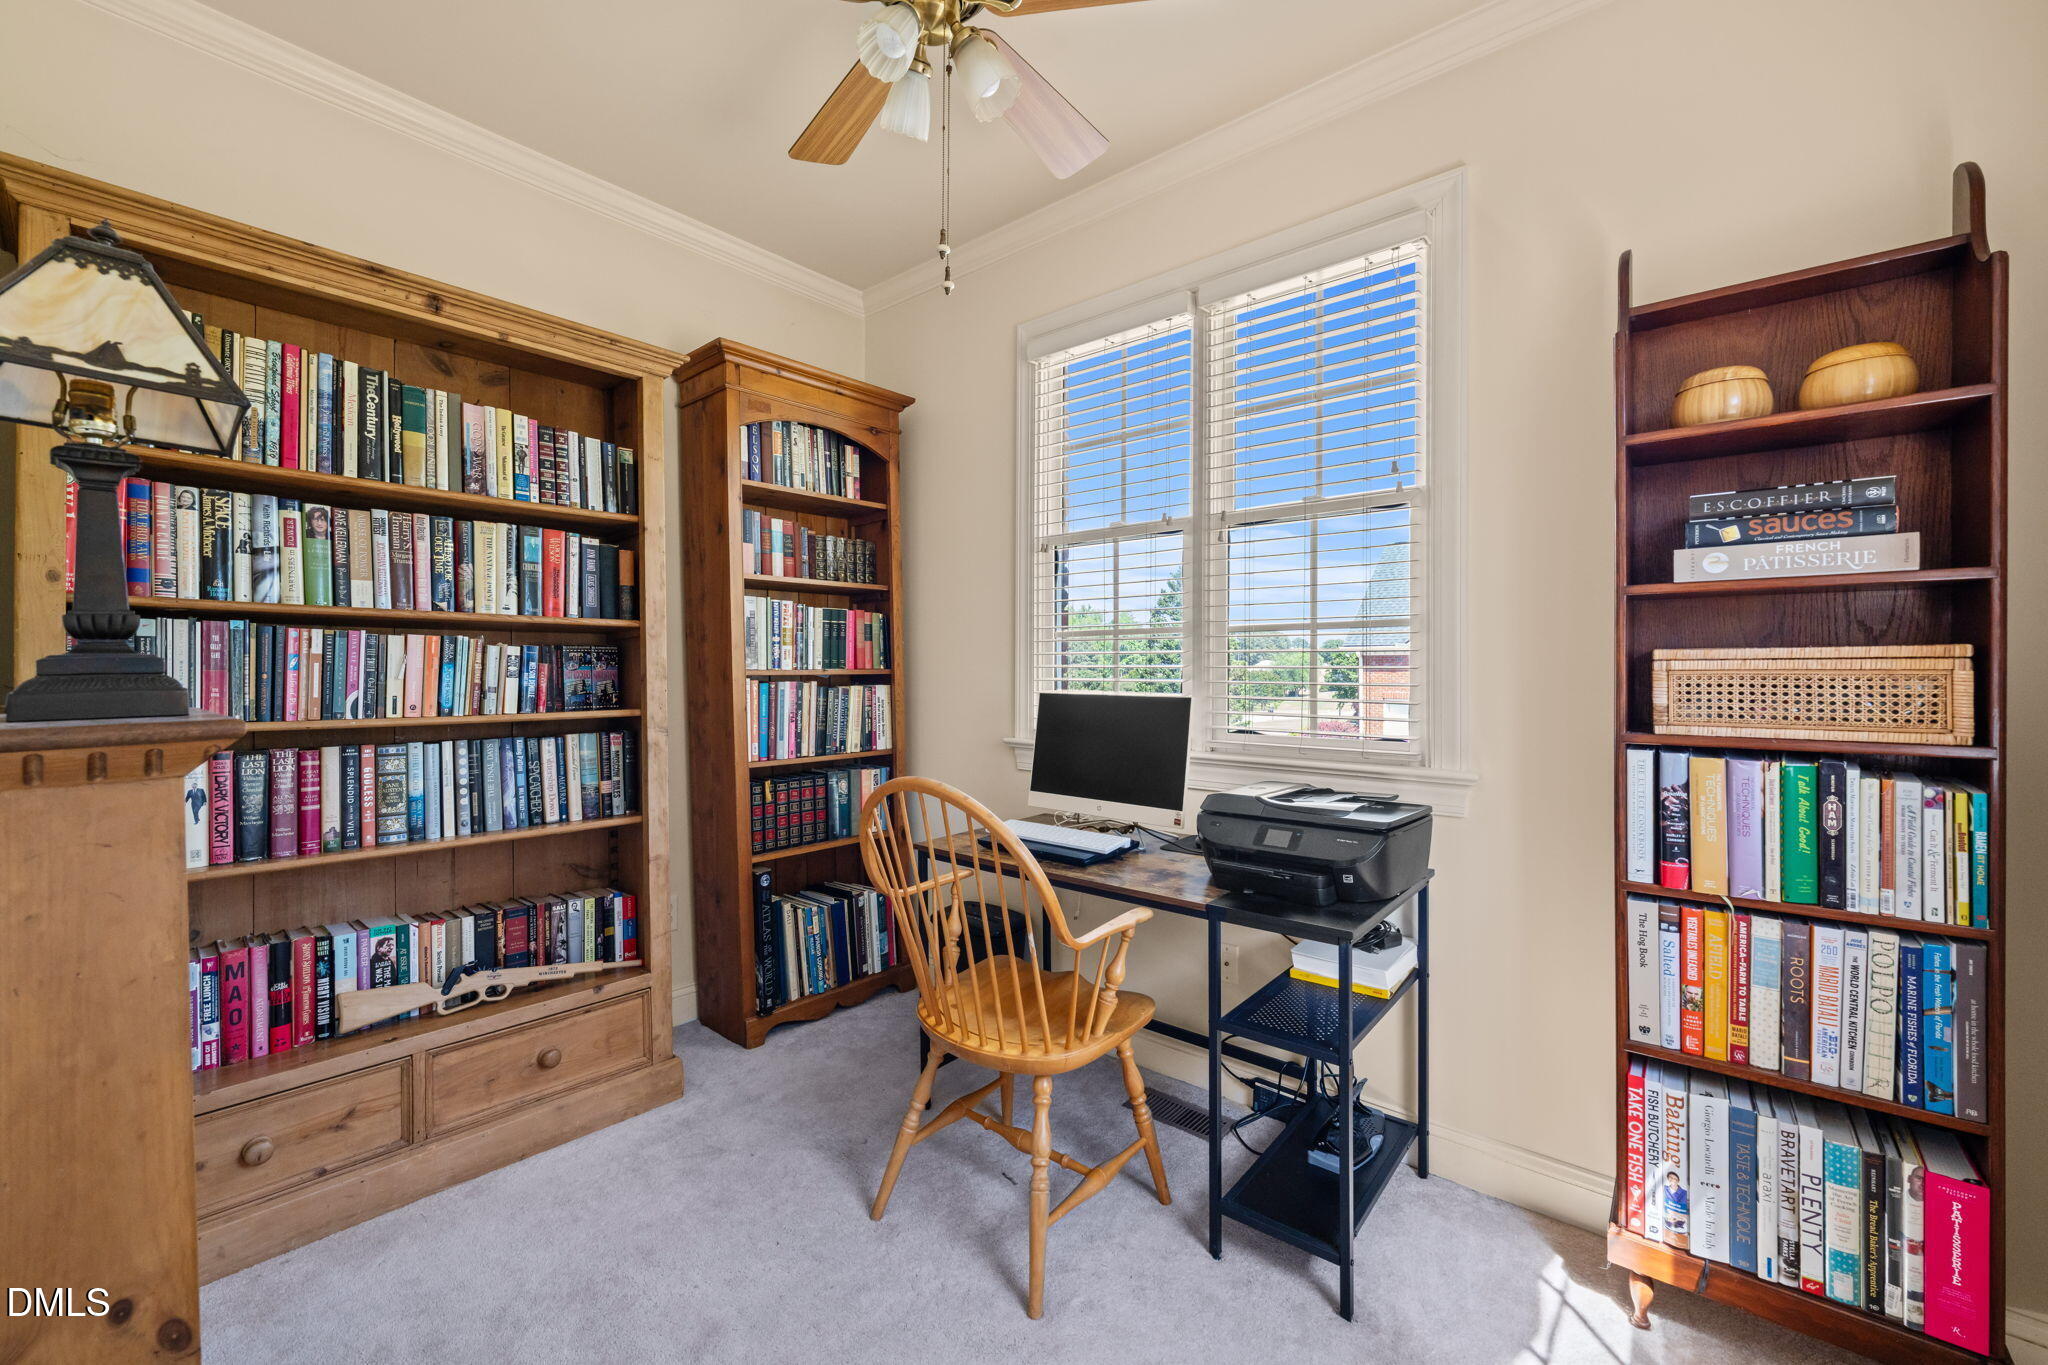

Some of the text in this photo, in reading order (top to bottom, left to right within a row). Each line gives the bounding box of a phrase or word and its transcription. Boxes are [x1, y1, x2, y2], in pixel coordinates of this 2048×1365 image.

[270, 389, 279, 413] School
[392, 415, 401, 453] Hollywood
[215, 497, 231, 529] SPACE
[263, 504, 271, 519] Keith
[403, 515, 411, 541] Harry
[1748, 511, 1854, 535] sauces
[137, 500, 147, 561] TOM BROKAW
[263, 521, 271, 546] Richards
[335, 510, 346, 564] FAYE KELLERMAN
[392, 514, 402, 550] Truman
[1776, 541, 1841, 554] FRENCH
[434, 537, 443, 573] OUR TIME
[443, 543, 453, 565] HERO
[587, 549, 596, 571] AYN RAND
[1743, 550, 1877, 571] PÂTISSERIE
[444, 566, 452, 580] FOR
[364, 767, 373, 808] GODLESS
[528, 761, 542, 813] SPYCATCHER
[612, 750, 621, 798] MOSCOW RULES
[215, 775, 228, 843] DARK VICTORY
[1706, 774, 1717, 842] TECHNIQUES
[1741, 776, 1750, 837] TECHNIQUES
[1797, 774, 1811, 854] Talk About Good!
[1827, 804, 1837, 827] HAM
[1907, 815, 1916, 831] Field
[1907, 832, 1916, 849] Guide
[1929, 829, 1938, 842] Can
[1975, 831, 1987, 854] RAMEN
[1907, 857, 1917, 878] Coastal
[1927, 849, 1940, 859] &
[1977, 855, 1984, 863] AT
[1907, 879, 1917, 897] Fishes
[1930, 860, 1938, 886] Ferment
[1977, 865, 1985, 886] HOME
[762, 904, 771, 941] ATLAS
[1637, 913, 1648, 968] The Hog Book
[1663, 939, 1676, 977] Salted
[1687, 917, 1698, 981] VEGETABLES UNLEASHED
[1709, 936, 1723, 980] AFIELD
[203, 975, 211, 1001] LUNCH
[375, 968, 383, 983] WAS
[764, 955, 773, 995] WORLD
[1739, 986, 1746, 996] TO
[1789, 957, 1804, 1004] ROOTS
[1850, 964, 1860, 989] WORLD
[1870, 938, 1896, 1015] POLPO
[317, 978, 329, 1025] NIGHT VISION
[1817, 965, 1840, 1027] MARIO BATALI
[1849, 990, 1859, 1019] CENTRAL
[1907, 975, 1917, 1011] MARINE
[256, 998, 264, 1042] ATONEMENT
[1848, 1020, 1858, 1049] KITCHEN
[1907, 1013, 1917, 1041] FISHES
[1821, 1028, 1829, 1058] AMERICAN
[1829, 1035, 1838, 1054] BIG
[1907, 1049, 1917, 1084] FLORIDA
[1628, 1087, 1643, 1183] TAKE ONE FISH
[1648, 1089, 1659, 1168] FISH BUTCHERY
[1662, 1093, 1685, 1168] Baking
[1703, 1105, 1715, 1175] Giorgio Locatelli
[1762, 1173, 1775, 1203] araxi
[1781, 1130, 1795, 1214] BRAVETART
[1736, 1143, 1751, 1244] TASTE & TECHNIQUE
[1703, 1195, 1715, 1250] Made In Italy
[1801, 1173, 1823, 1256] PLENTY
[1868, 1200, 1878, 1298] The Bread Baker's Apprentice
